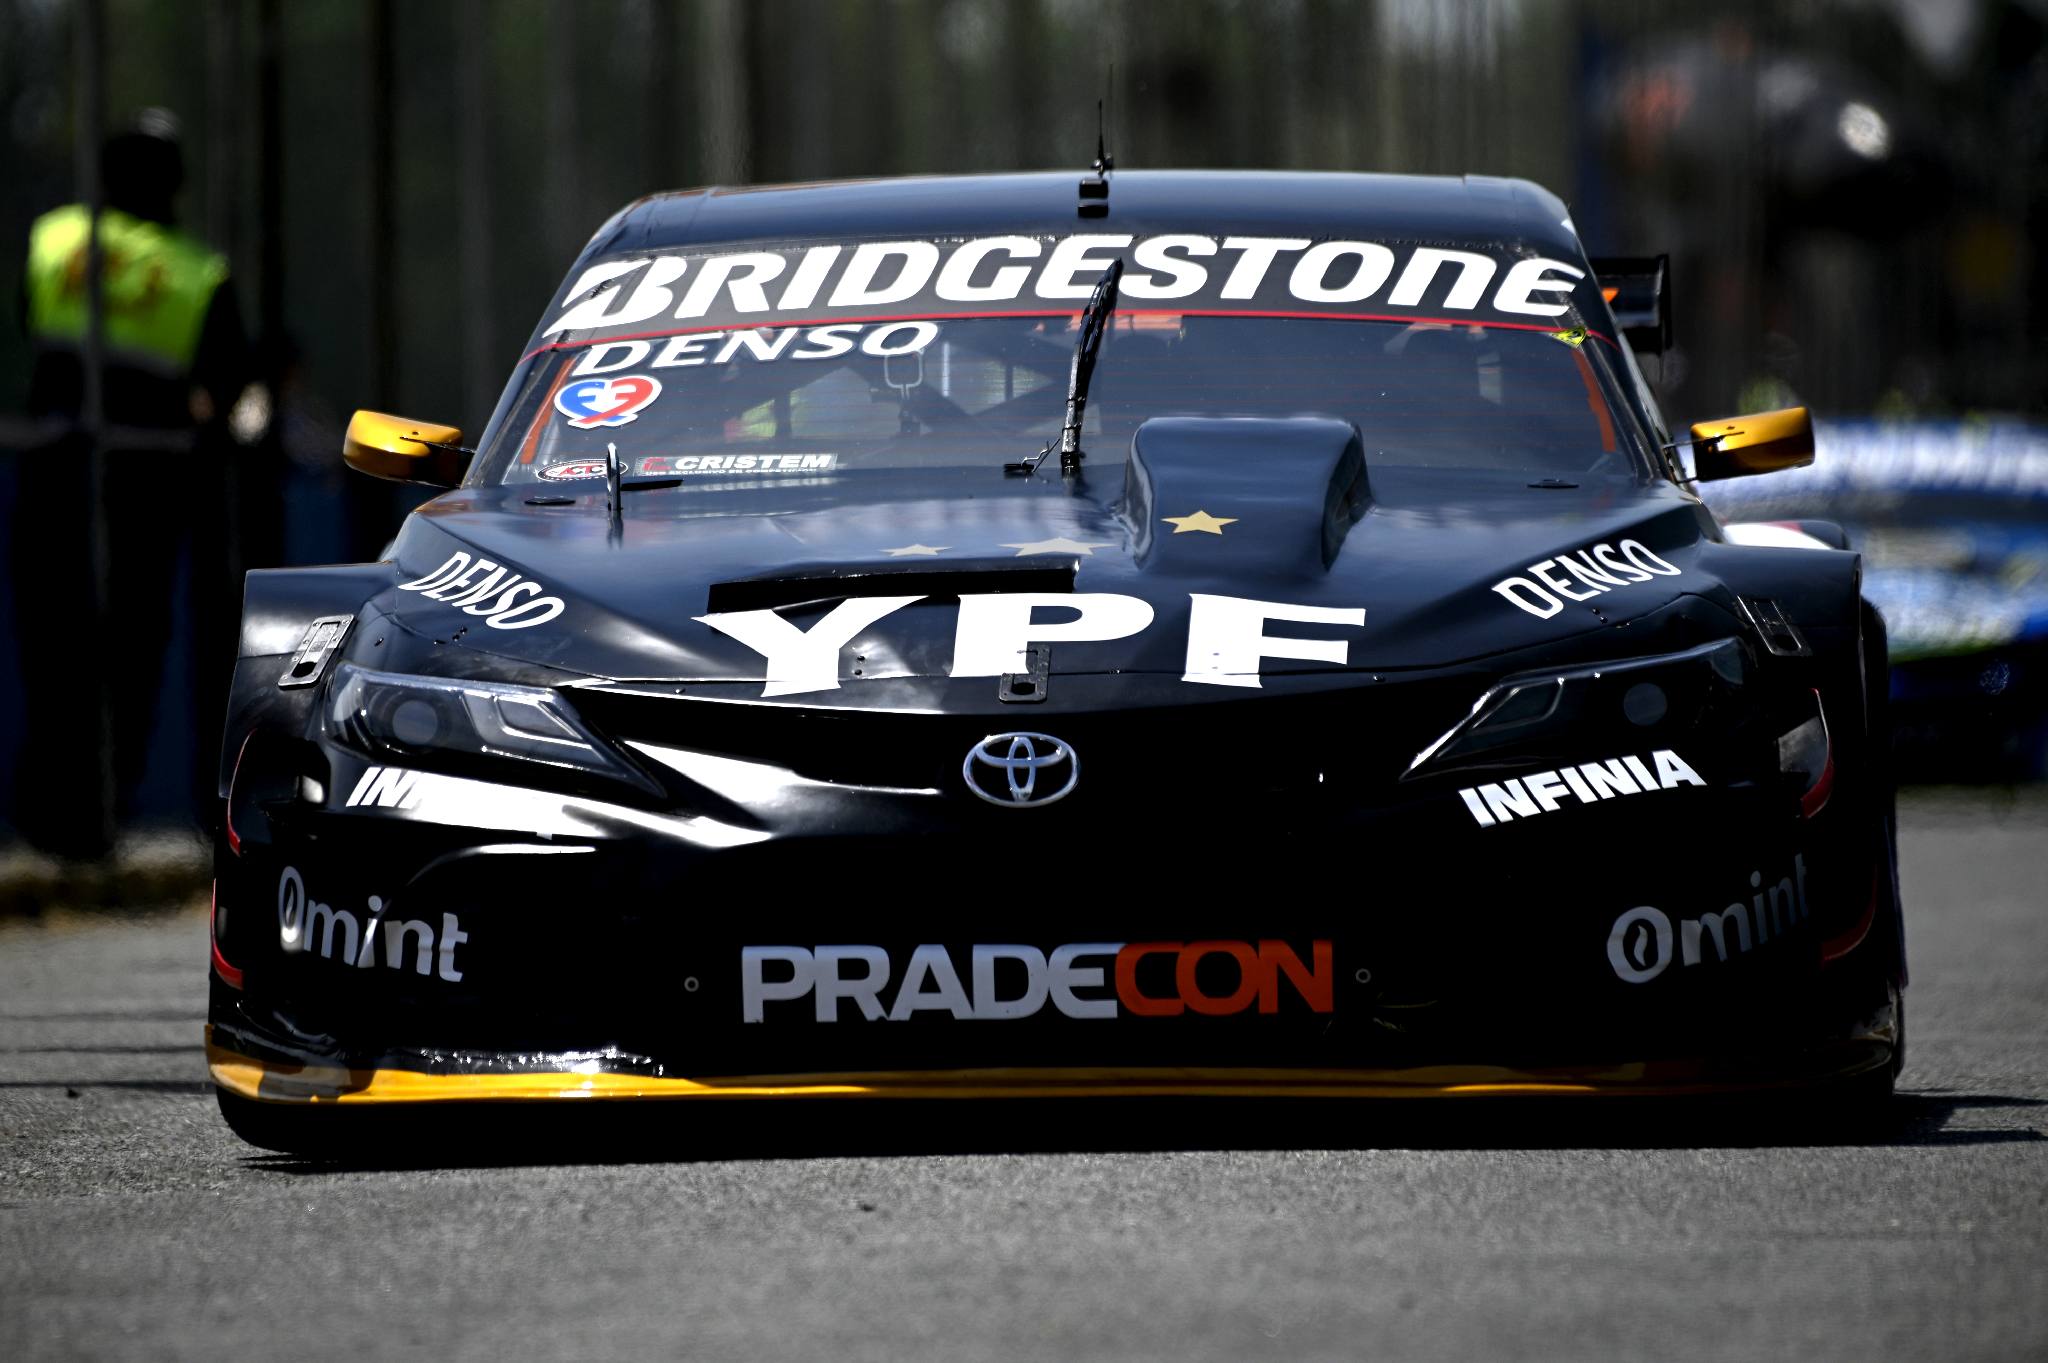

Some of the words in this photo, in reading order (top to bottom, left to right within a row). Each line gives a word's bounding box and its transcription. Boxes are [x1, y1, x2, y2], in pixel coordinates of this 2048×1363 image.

[541, 233, 1586, 338] BRIDGESTONE
[571, 320, 940, 377] DENSO
[675, 453, 832, 471] CRISTEM
[399, 551, 566, 629] DENSO
[1491, 539, 1682, 619] DENSO
[691, 592, 1366, 697] YPF
[1458, 749, 1707, 828] INFINIA
[278, 865, 469, 983] Omint
[741, 939, 1334, 1023] PRADECON
